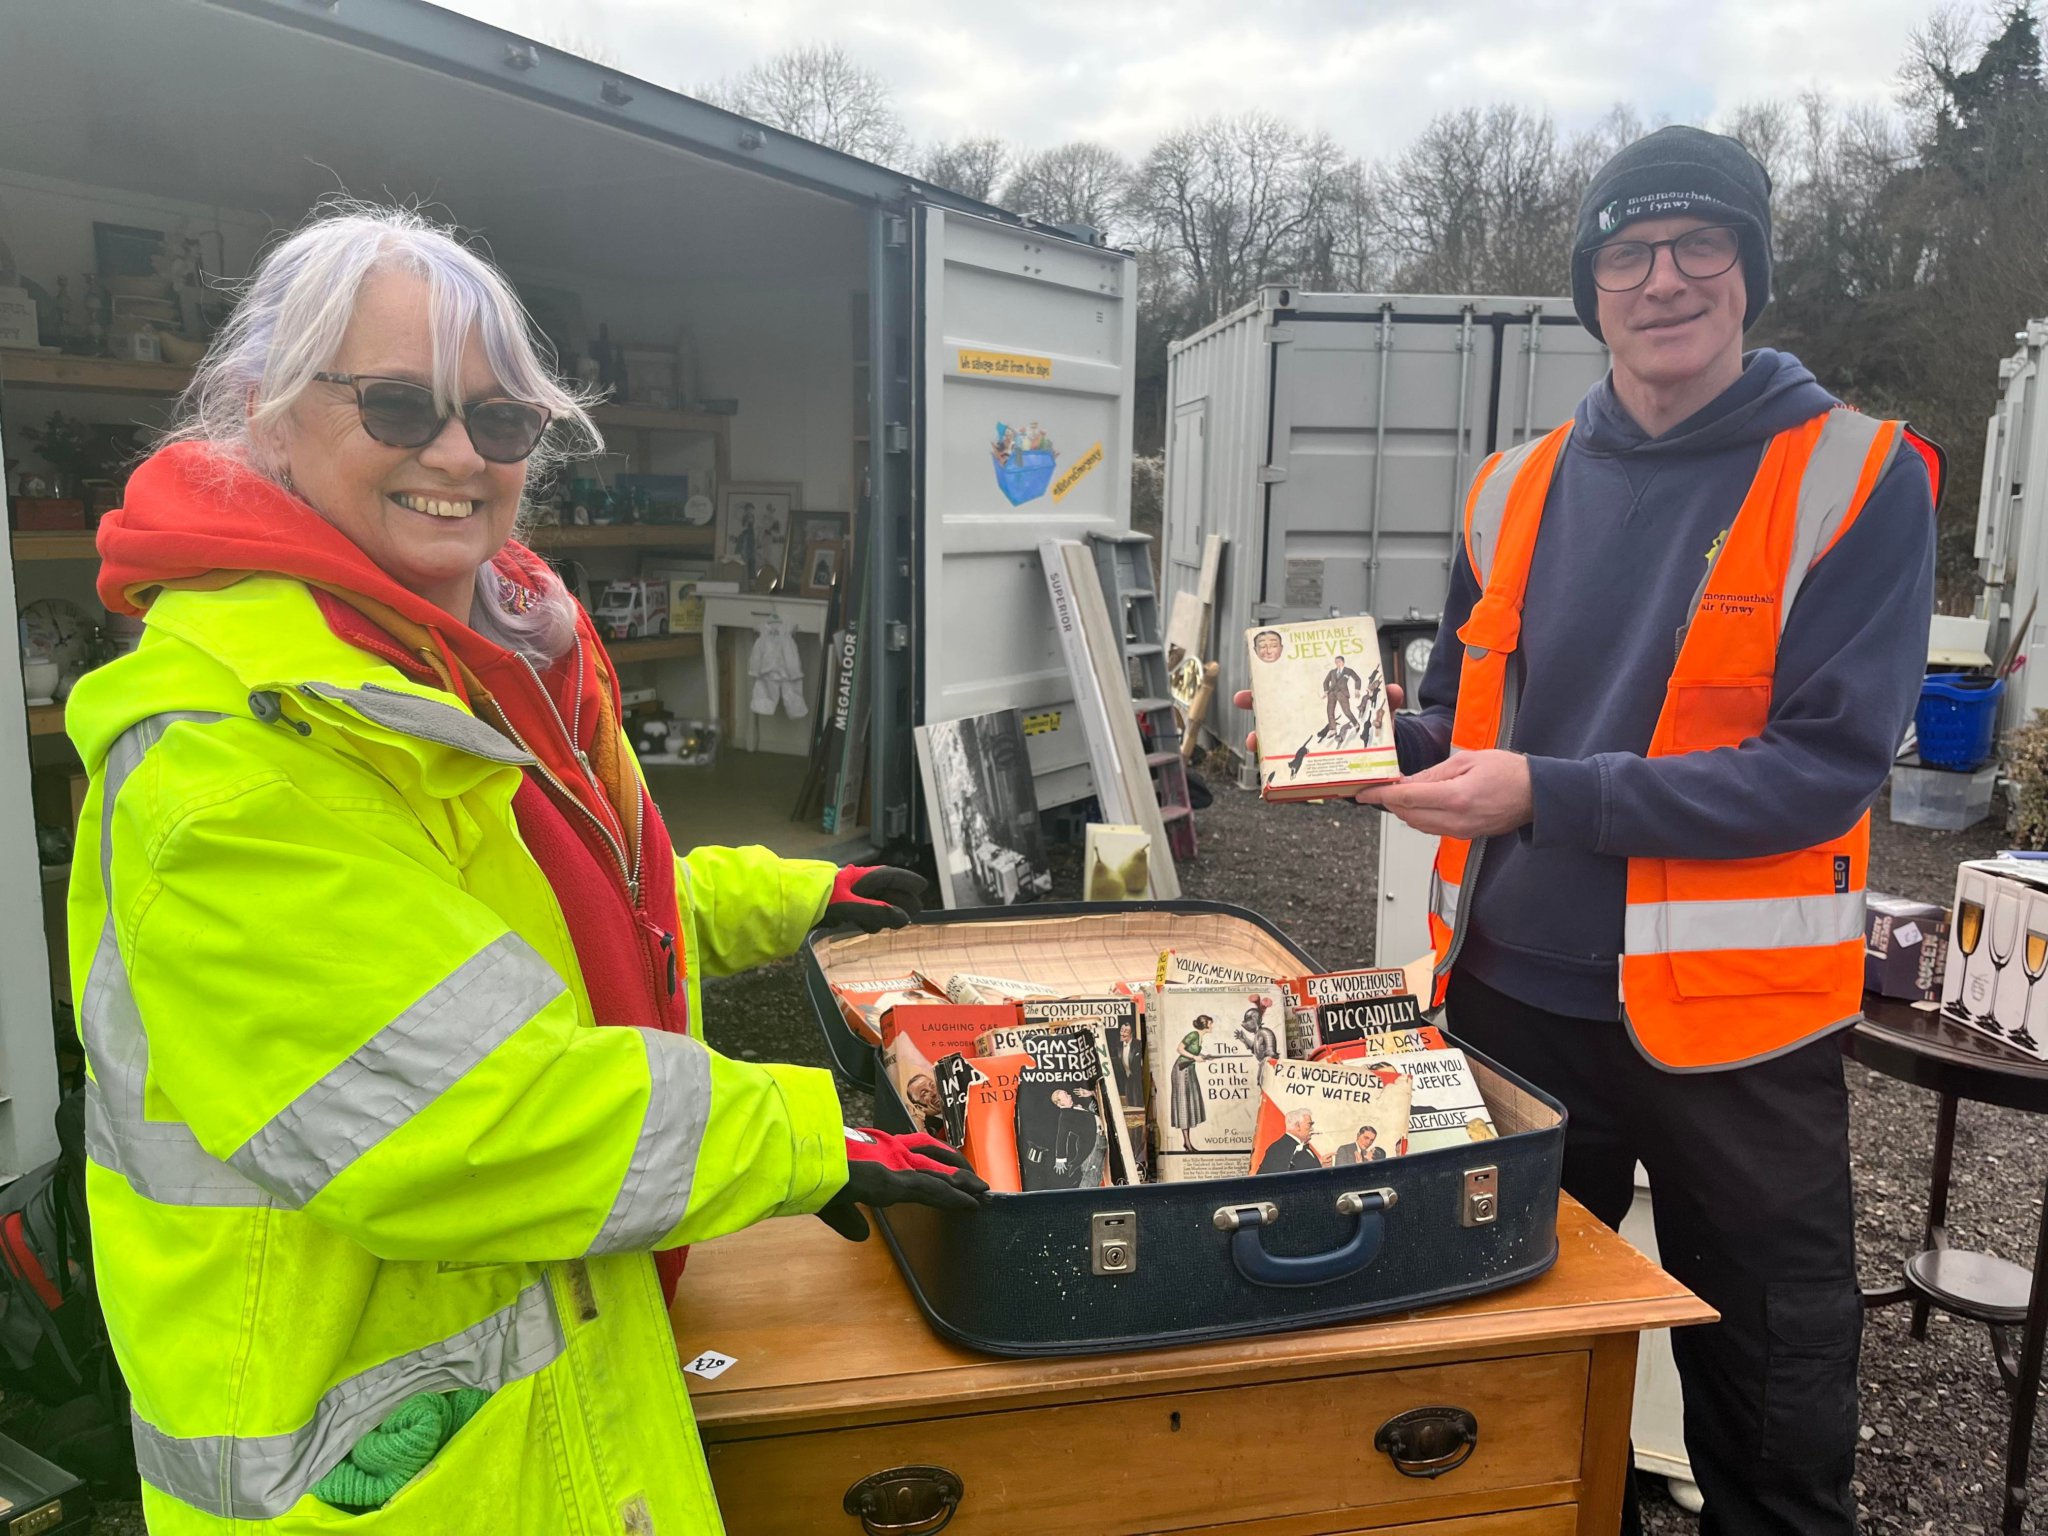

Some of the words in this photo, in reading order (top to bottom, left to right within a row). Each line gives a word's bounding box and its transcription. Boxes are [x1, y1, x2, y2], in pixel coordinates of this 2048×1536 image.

[1626, 206, 1641, 216] sir
[1649, 200, 1691, 212] fynwy
[1050, 572, 1072, 633] SUPERIOR
[1701, 602, 1714, 610] sir
[1720, 603, 1754, 616] fynwy
[1289, 626, 1356, 643] INIMITABLE
[1287, 638, 1364, 660] JEEVES
[835, 634, 857, 730] MEGAFLOOR
[1835, 861, 1846, 888] LEO
[1176, 957, 1208, 975] YOUNG
[1209, 966, 1232, 980] MEN
[1915, 933, 1938, 990] QUEEN
[1332, 972, 1402, 992] WODEHOUSE
[1041, 1003, 1129, 1016] COMPULSORY
[1325, 1001, 1415, 1032] PICCADILLY
[922, 1023, 974, 1032] LAUGHING
[1025, 1033, 1090, 1054] DAMSEL
[1393, 1032, 1431, 1048] DAYS
[1215, 1043, 1238, 1054] The
[1025, 1047, 1096, 1070] ISTRESS
[1022, 1067, 1097, 1082] WODEHOUSE
[1208, 1063, 1248, 1074] GIRL
[1400, 1061, 1440, 1075] THANK
[1229, 1076, 1248, 1086] the
[1301, 1067, 1384, 1089] WODEHOUSE
[1417, 1074, 1461, 1089] JEEVES
[980, 1089, 997, 1104] IN
[1208, 1088, 1250, 1100] BOAT
[1286, 1083, 1315, 1096] HOT
[1322, 1087, 1371, 1104] WATER
[1205, 1136, 1253, 1144] WODEHOUS
